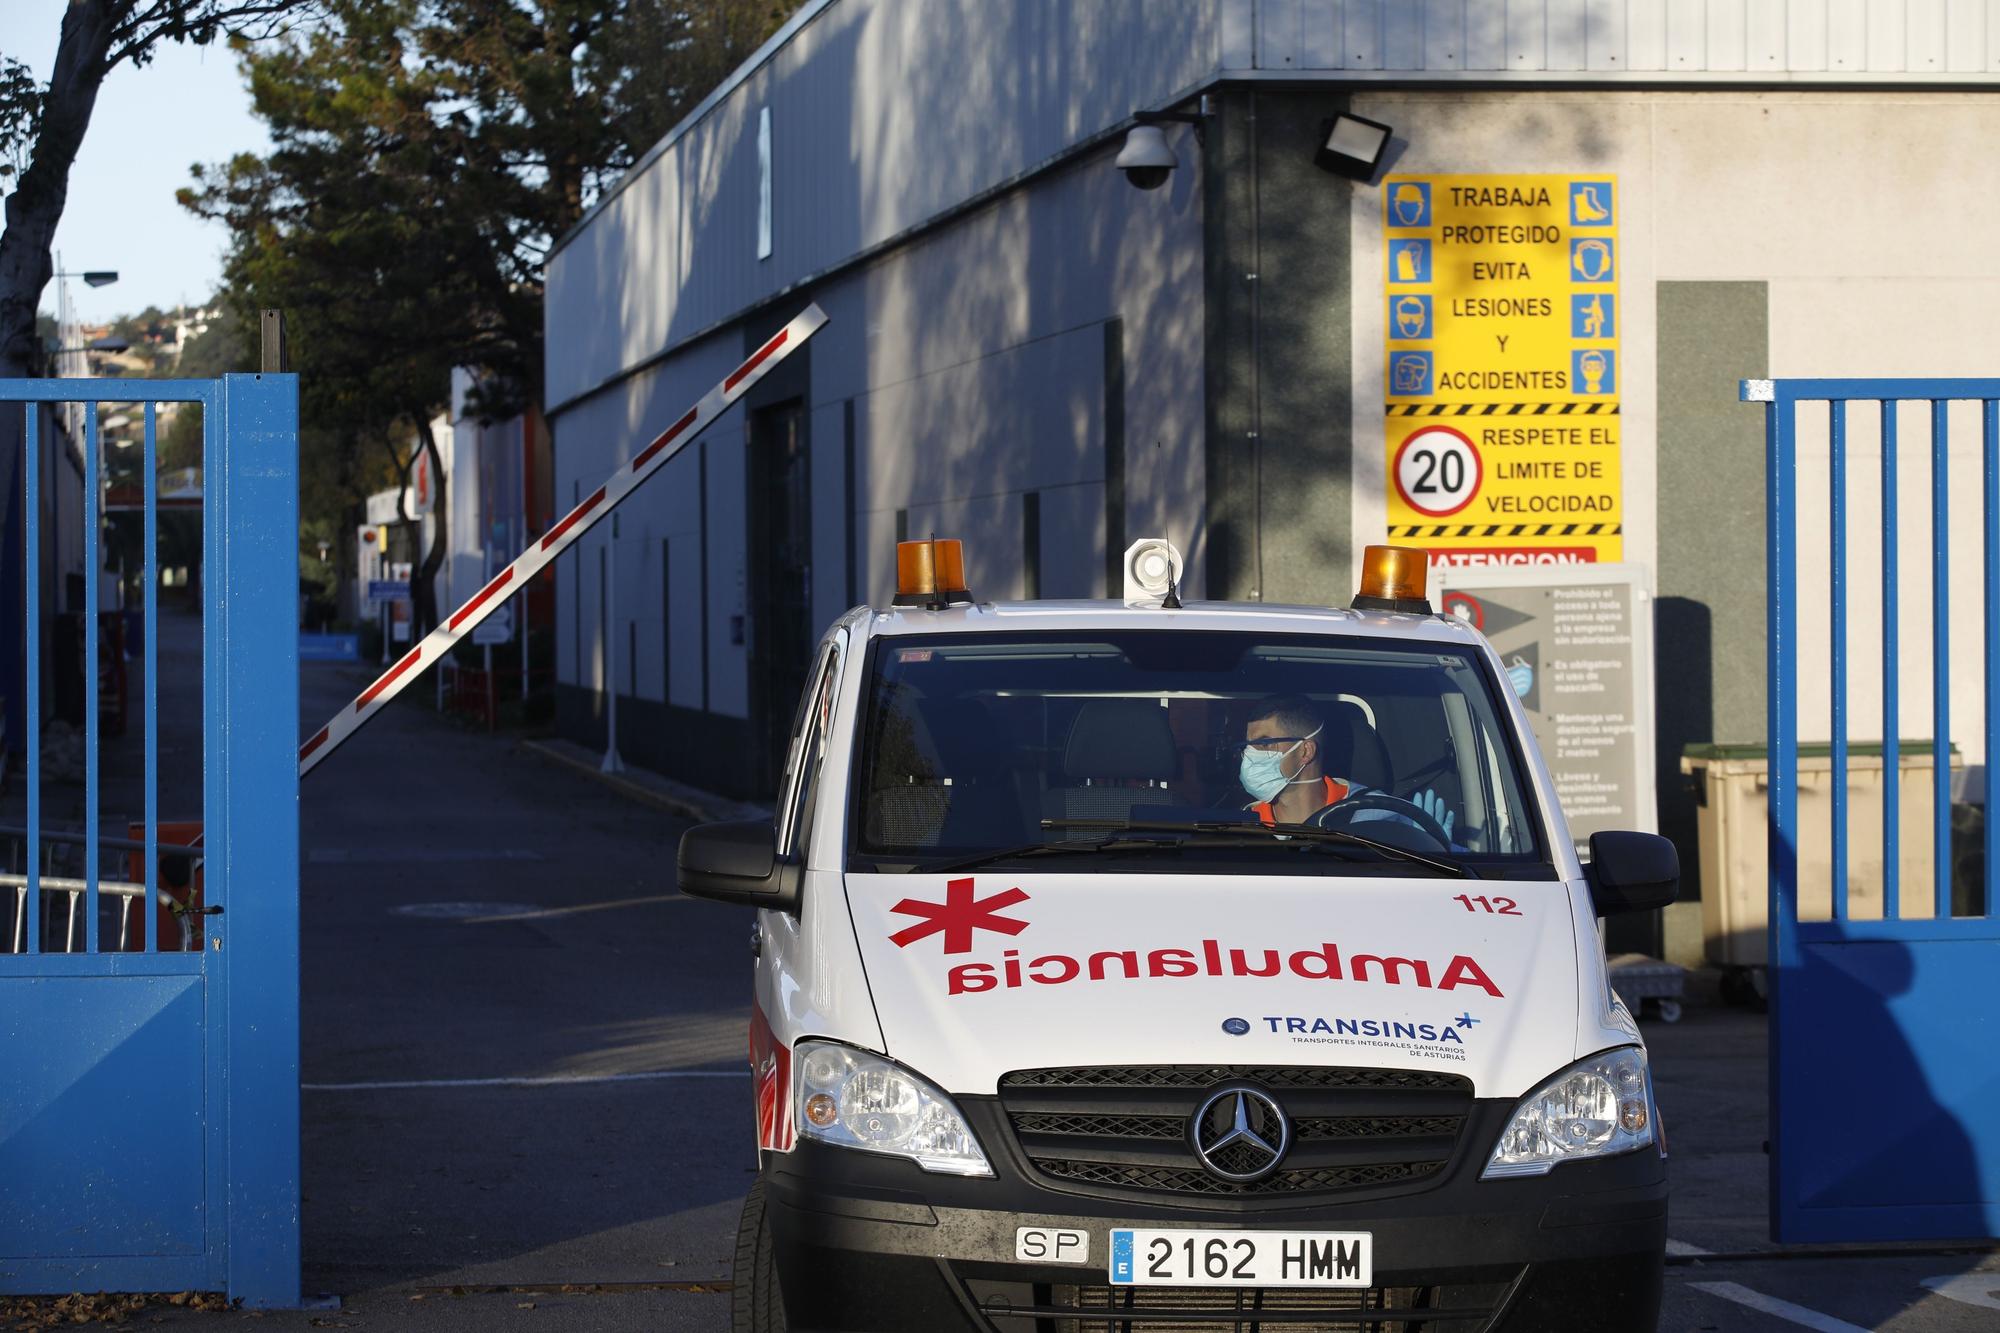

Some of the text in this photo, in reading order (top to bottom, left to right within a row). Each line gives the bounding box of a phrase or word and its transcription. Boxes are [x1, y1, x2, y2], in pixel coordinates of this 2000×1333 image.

[1451, 187, 1551, 207] TRABAJA
[1442, 225, 1560, 244] PROTEGIDO
[1473, 262, 1531, 280] EVITA
[1453, 298, 1552, 317] LESIONES
[1496, 335, 1509, 352] Y
[1439, 371, 1567, 390] ACCIDENTES
[1482, 428, 1616, 445] RESPETE EL
[1412, 449, 1464, 494] 20
[1497, 461, 1603, 479] LIMITE DE
[1486, 495, 1613, 513] VELOCIDAD
[1553, 589, 1601, 599] Prohibido
[1453, 894, 1523, 916] 112
[1263, 1017, 1464, 1044] TRANSINSA
[1292, 1037, 1465, 1055] TRANSPORTES INTEGRALES SANITARIOS
[1424, 1052, 1466, 1062] ASTURIAS
[1023, 1231, 1080, 1259] SP
[1118, 1262, 1128, 1274] E
[1147, 1237, 1361, 1281] 2162 HMM
